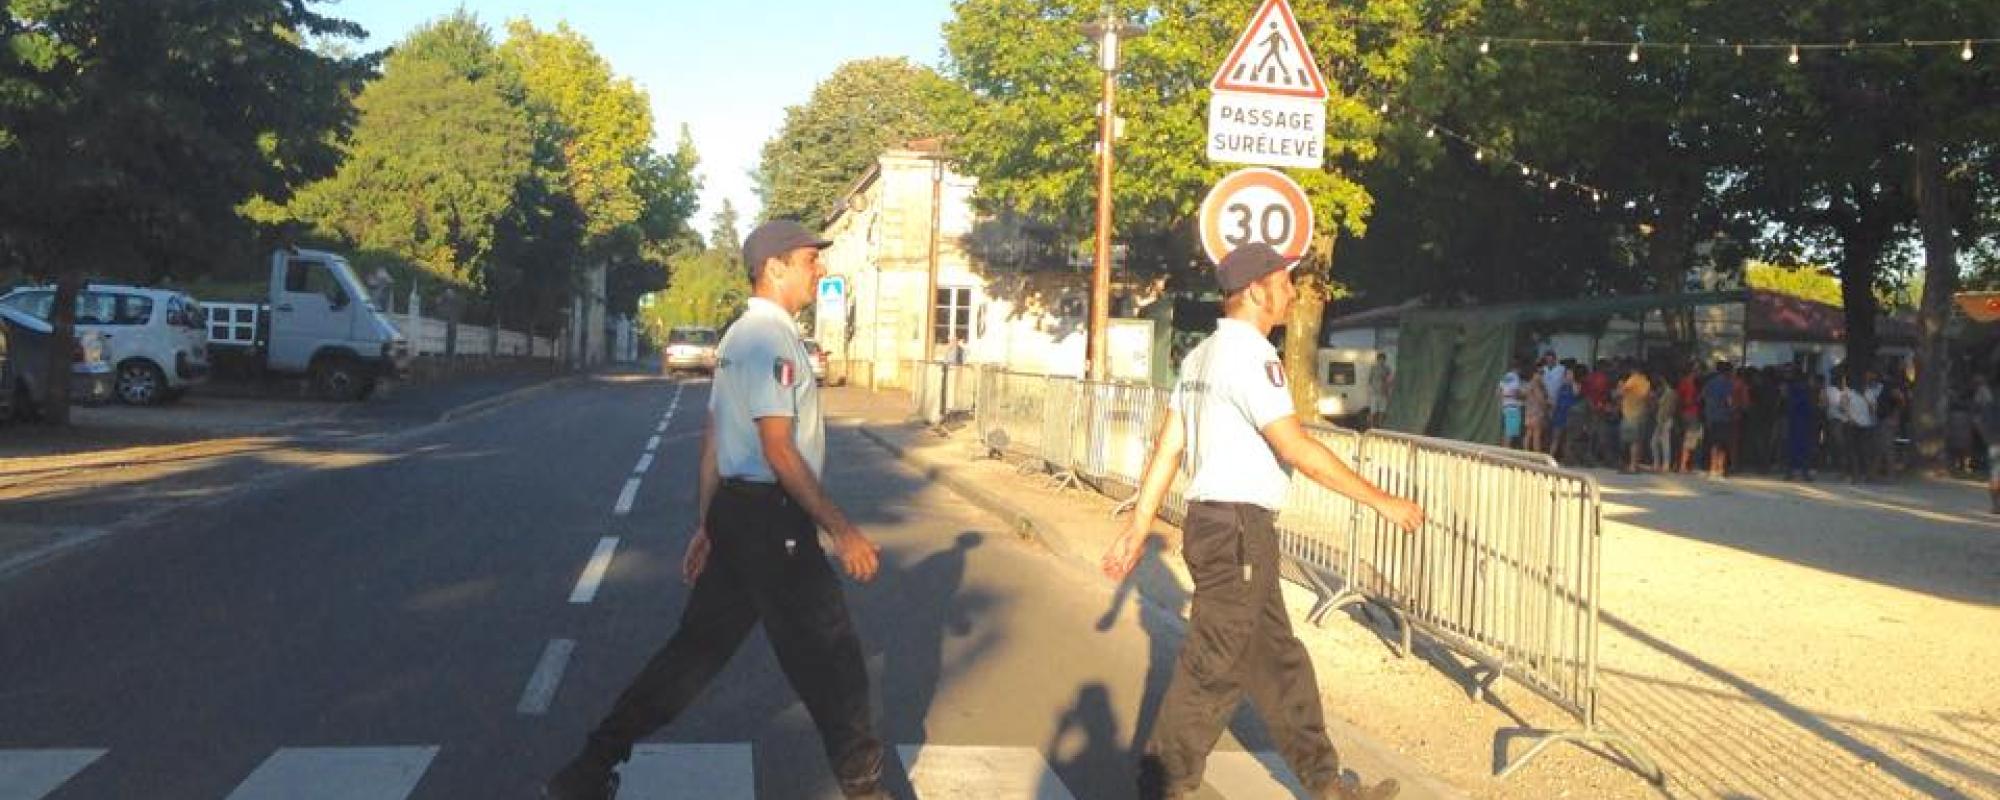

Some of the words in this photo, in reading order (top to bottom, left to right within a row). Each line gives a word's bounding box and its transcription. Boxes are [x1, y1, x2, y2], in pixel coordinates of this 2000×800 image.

[1220, 105, 1314, 131] PASSAGE
[1213, 132, 1318, 159] SURÉLEVÉ
[1225, 203, 1291, 246] 30
